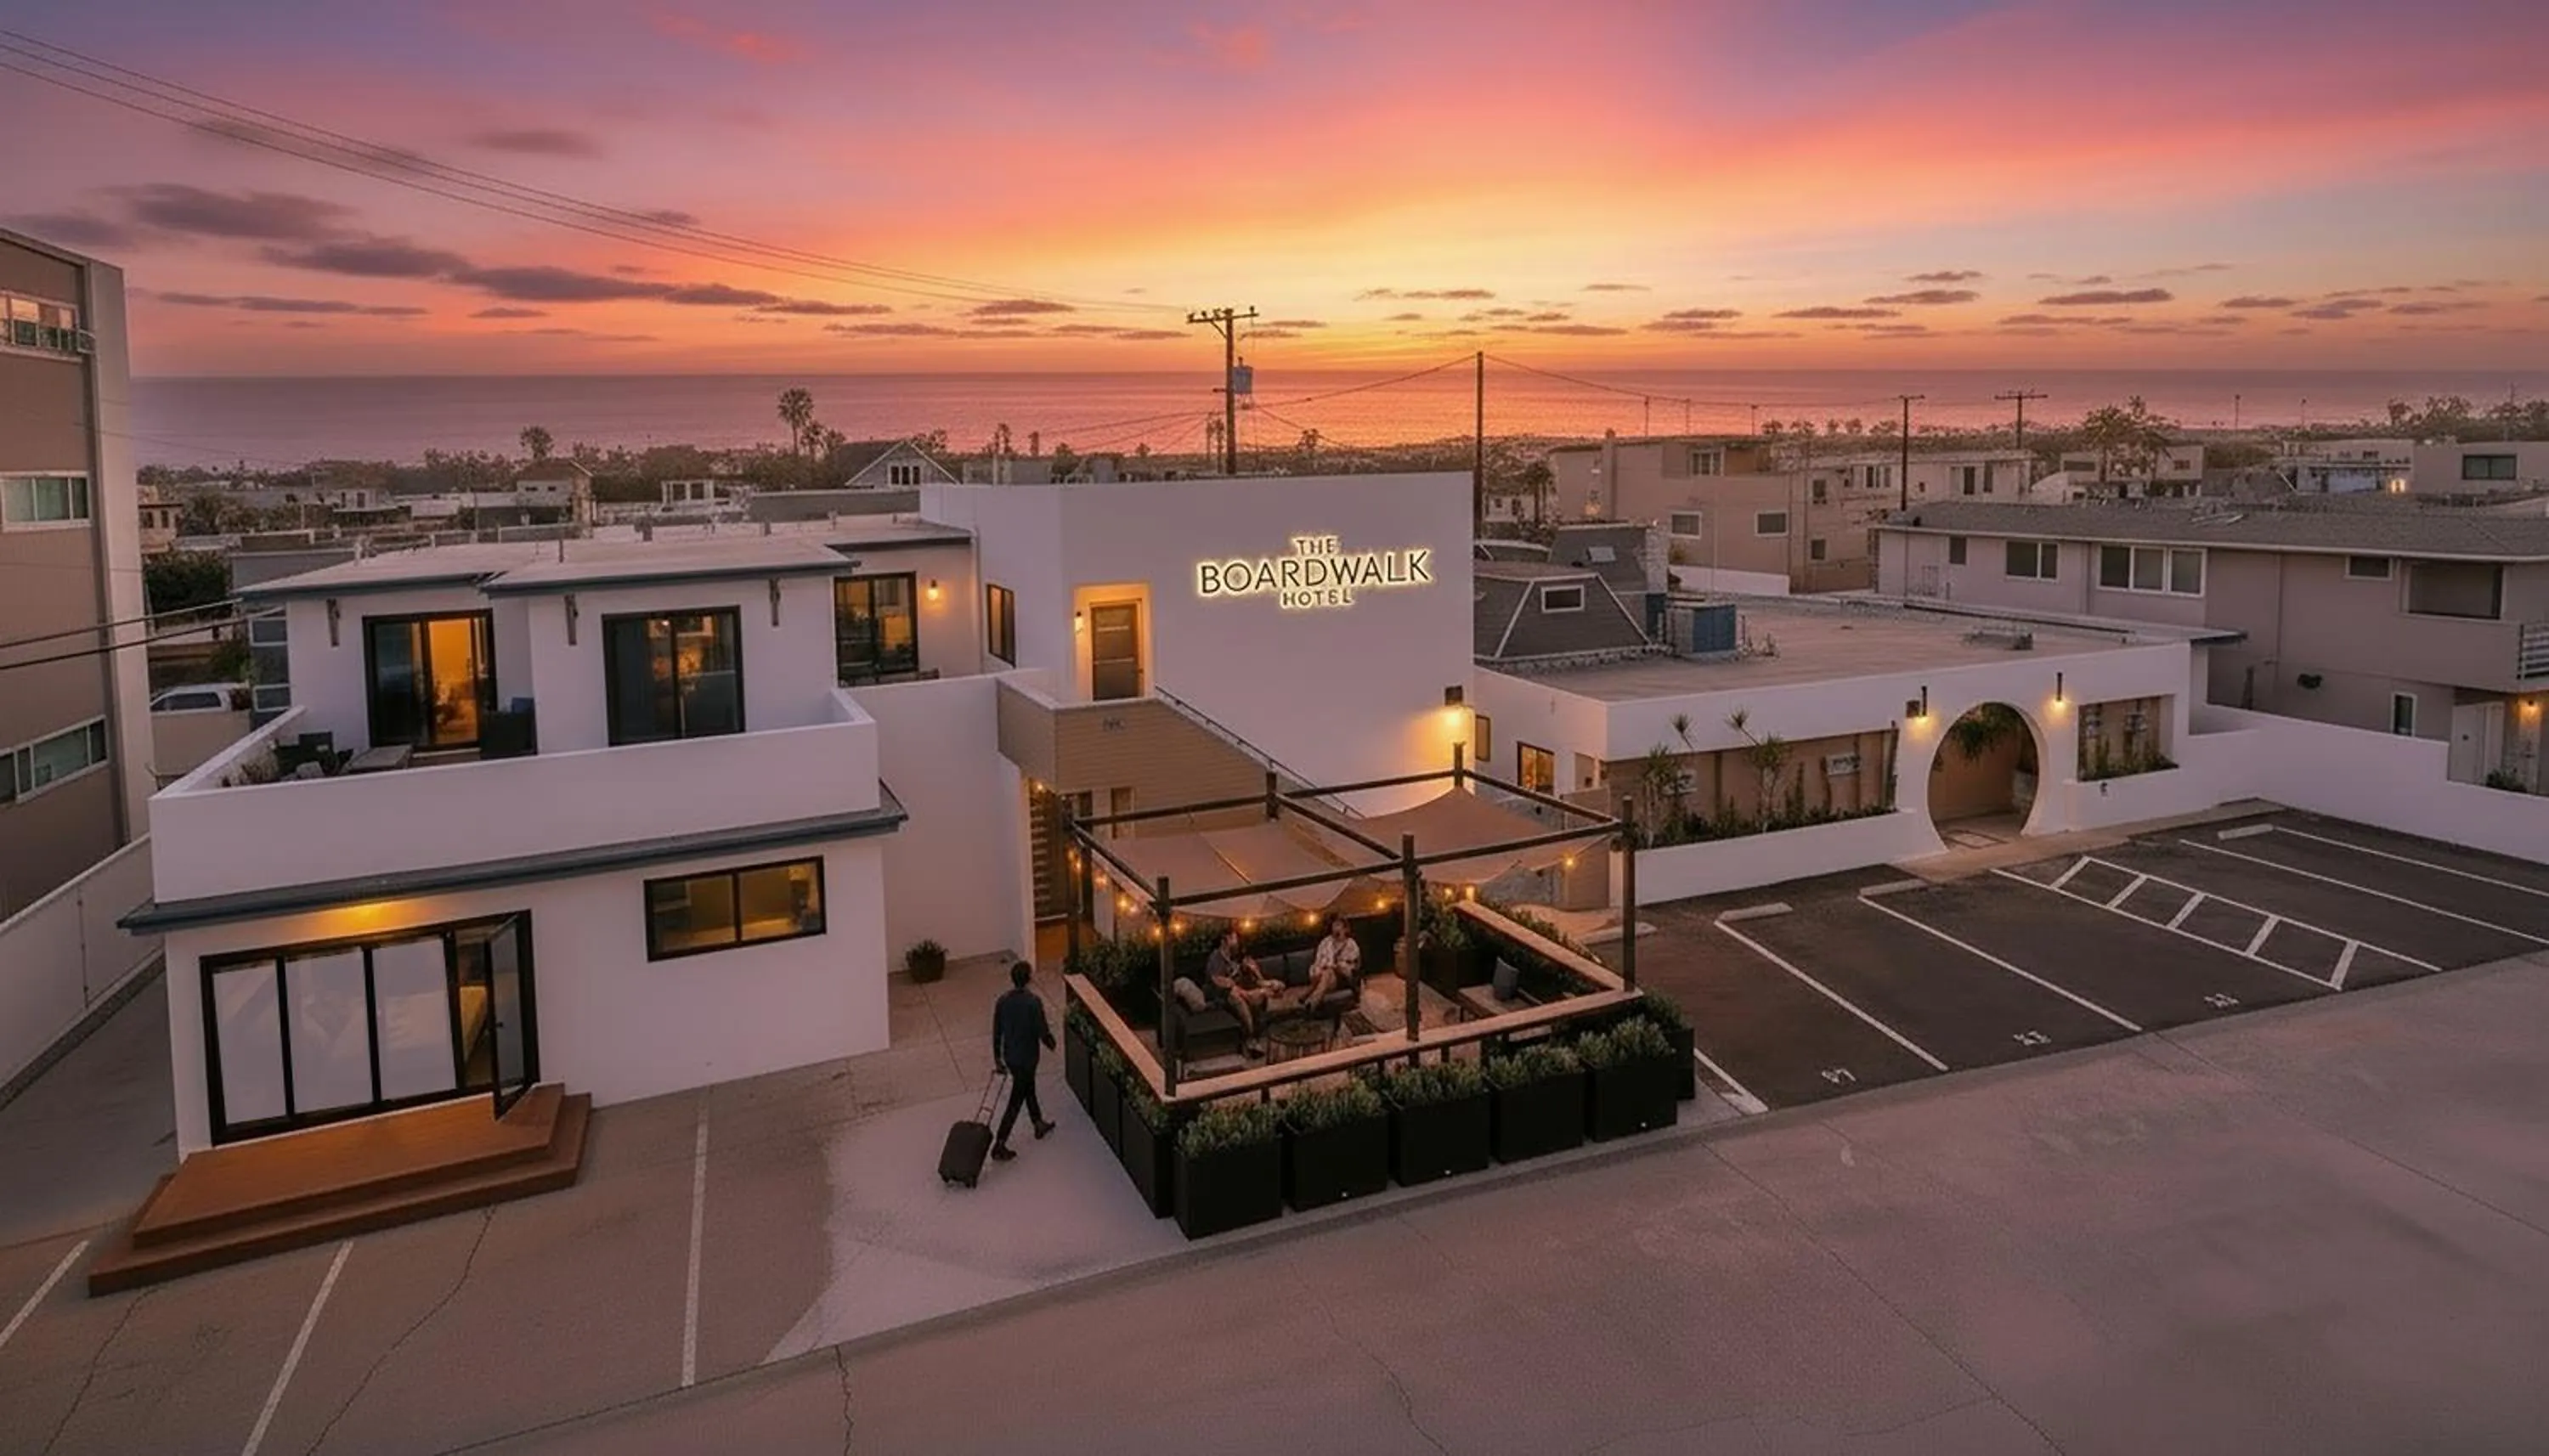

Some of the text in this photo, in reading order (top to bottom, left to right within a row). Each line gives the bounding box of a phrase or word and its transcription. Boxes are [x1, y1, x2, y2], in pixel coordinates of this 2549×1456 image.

[1296, 538, 1336, 555] THE
[1200, 550, 1430, 594] BOARDWALK
[1282, 590, 1353, 607] HOTEL
